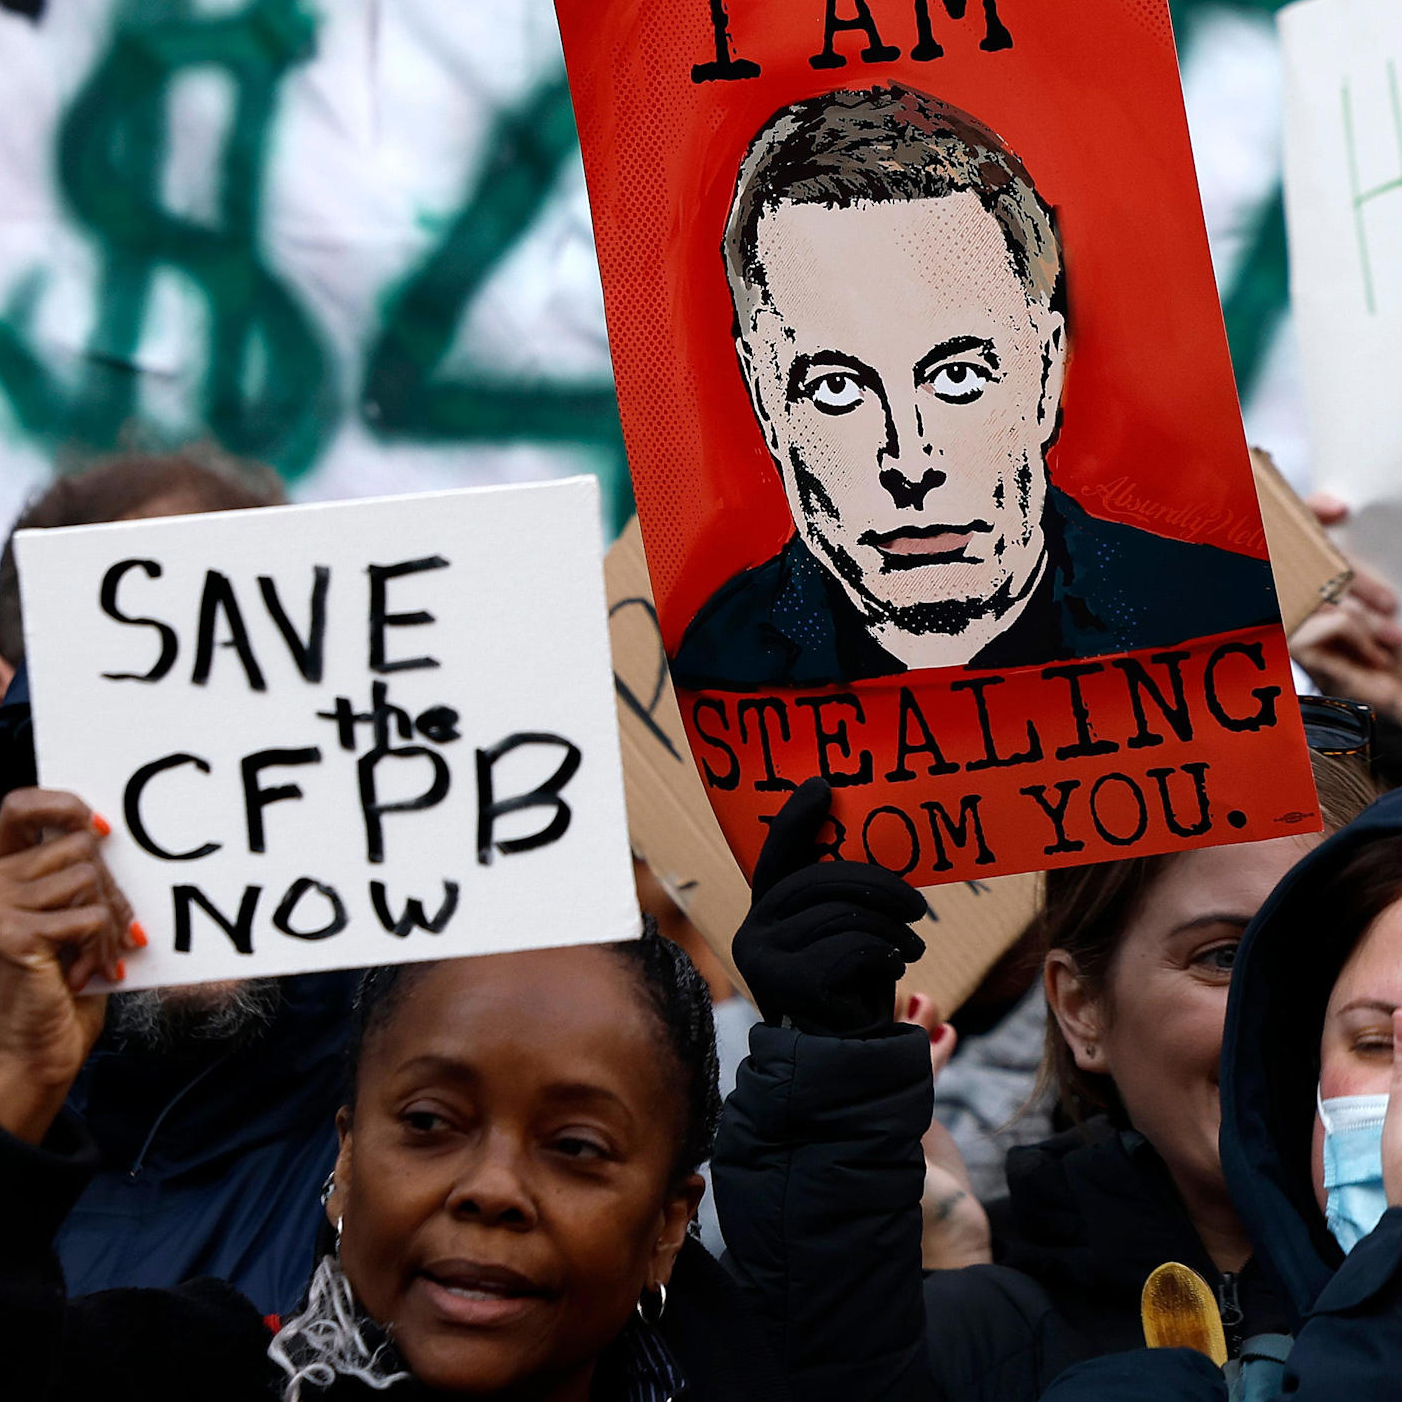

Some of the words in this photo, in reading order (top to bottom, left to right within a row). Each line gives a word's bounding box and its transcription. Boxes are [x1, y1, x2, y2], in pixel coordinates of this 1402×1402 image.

[98, 555, 451, 692] SAVE
[315, 680, 462, 752] the
[694, 641, 1285, 792] STEALING
[121, 732, 583, 866] CFPB
[758, 791, 998, 878] ROM
[1018, 762, 1249, 858] YOU.
[170, 876, 460, 956] NOW
